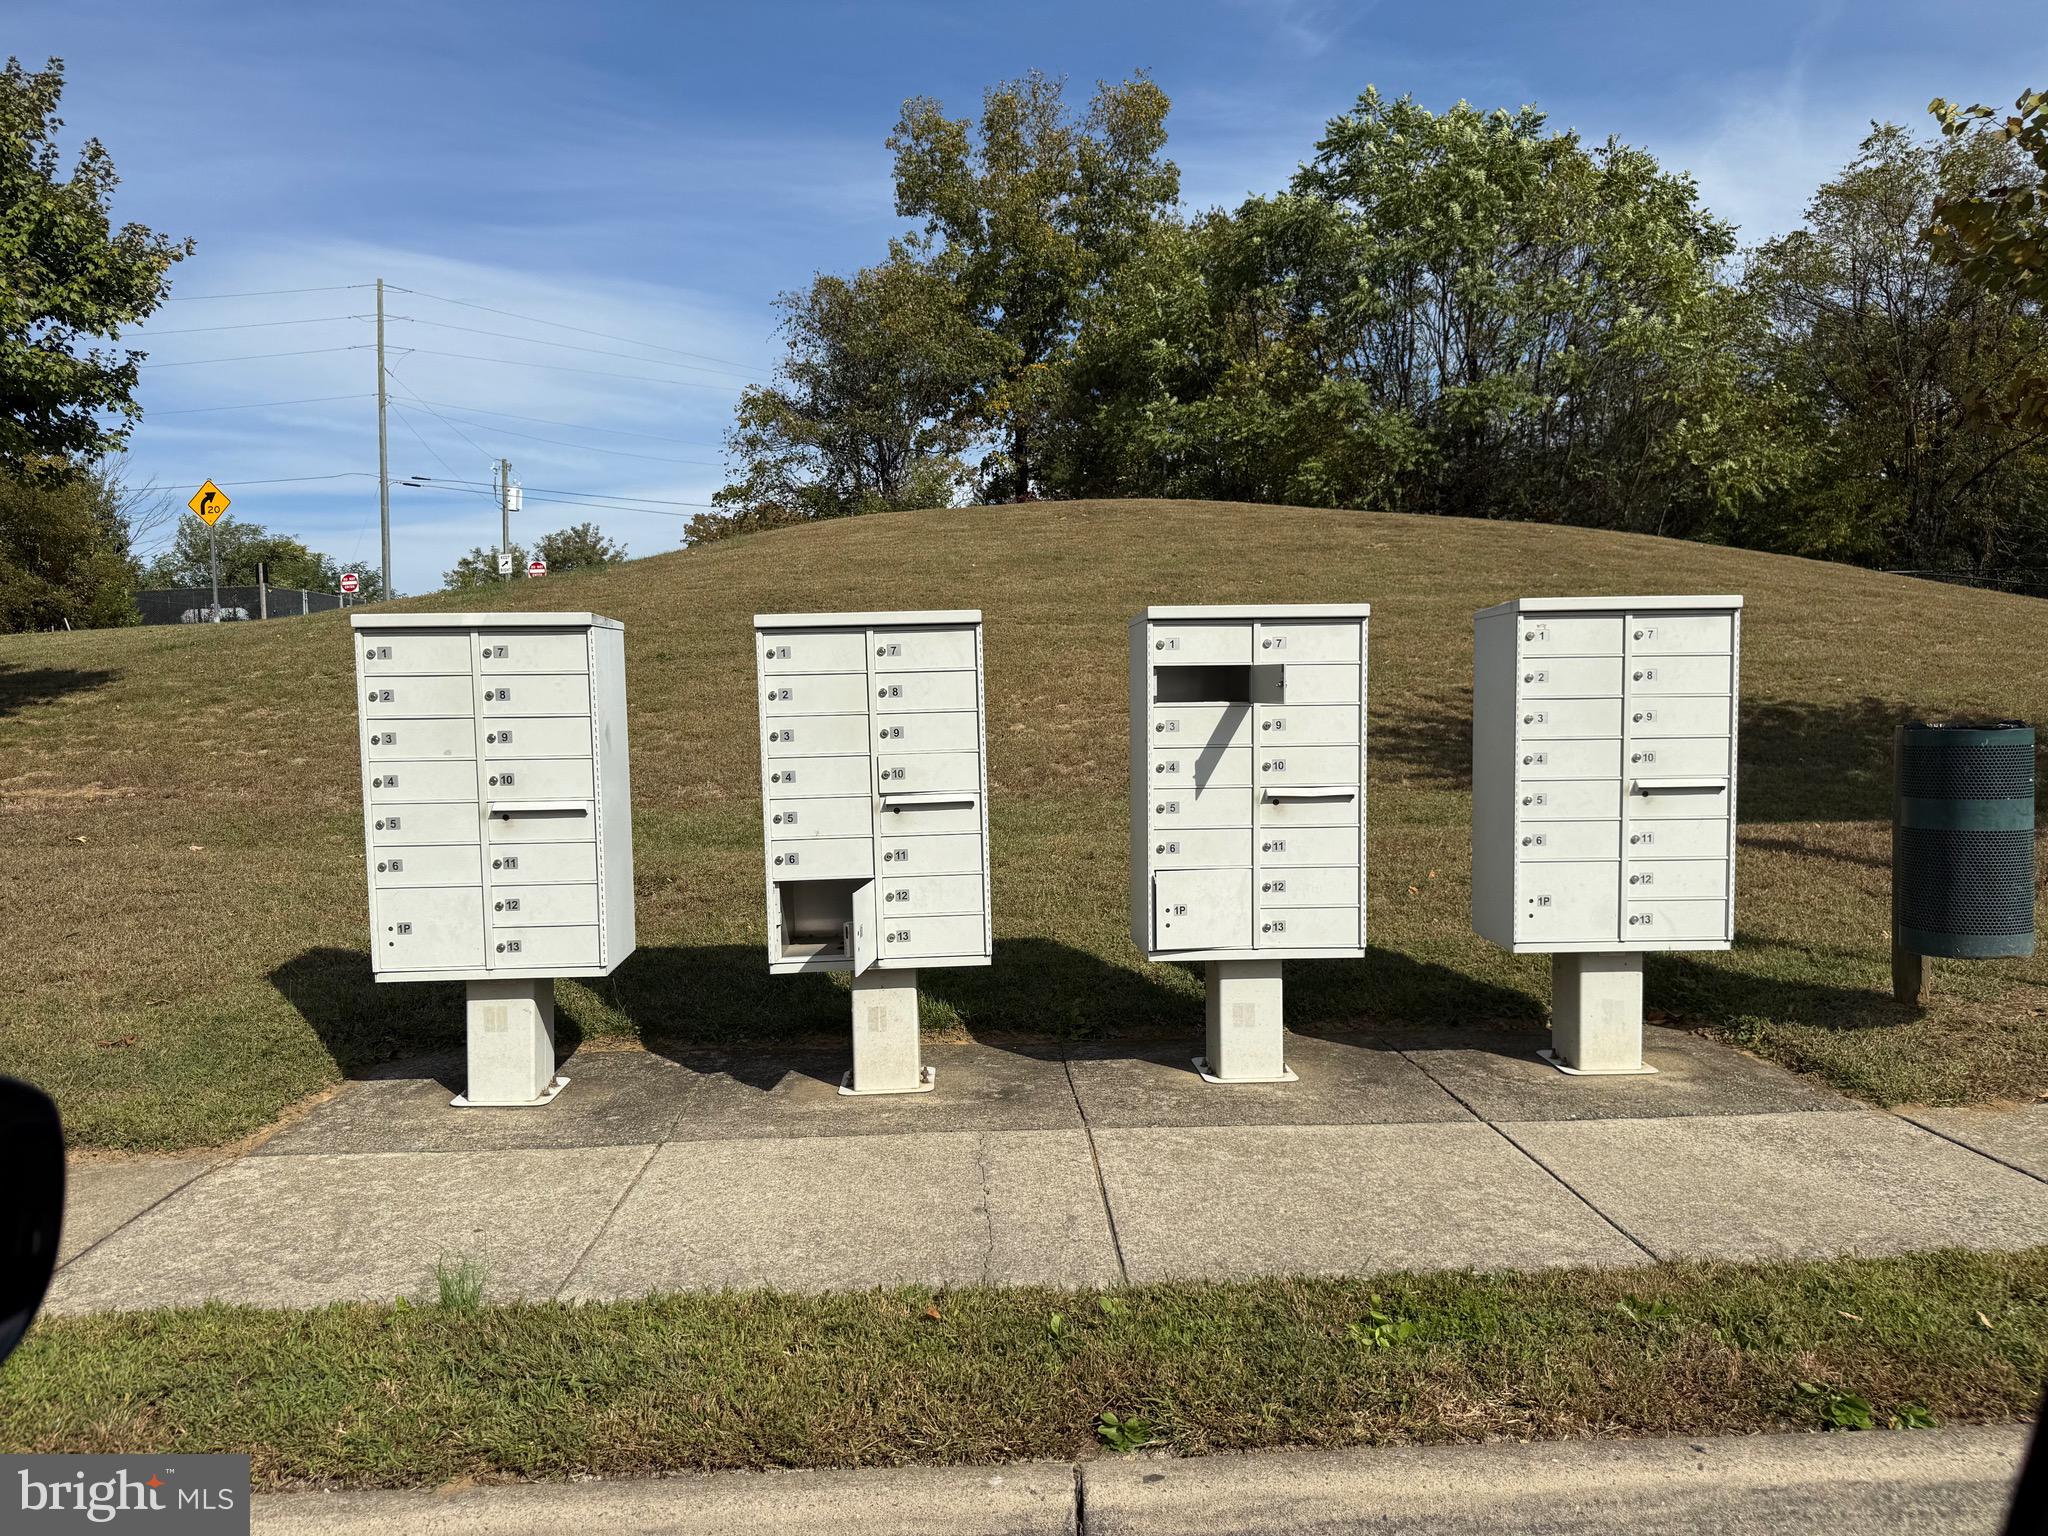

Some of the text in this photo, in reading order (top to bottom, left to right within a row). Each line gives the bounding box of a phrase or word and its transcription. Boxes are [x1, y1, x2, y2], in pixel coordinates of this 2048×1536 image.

[208, 505, 220, 514] 20
[1539, 631, 1544, 641] 1
[1647, 629, 1654, 639] 7
[1169, 639, 1175, 649] 1
[1276, 638, 1282, 648] 7
[381, 648, 387, 659] 1
[497, 647, 504, 657] 7
[780, 648, 786, 658] 1
[890, 646, 897, 656] 7
[1537, 672, 1545, 682] 2
[1646, 670, 1653, 680] 8
[383, 691, 391, 701] 2
[499, 690, 506, 700] 8
[782, 690, 789, 700] 2
[892, 687, 899, 697] 8
[1537, 713, 1544, 723] 3
[1646, 712, 1653, 721] 9
[1169, 721, 1176, 731] 3
[1275, 720, 1282, 730] 9
[501, 732, 508, 742] 9
[783, 731, 790, 741] 3
[893, 728, 900, 738] 9
[385, 734, 393, 744] 3
[1536, 754, 1544, 763] 4
[1642, 753, 1654, 762] 10
[1169, 762, 1176, 772] 4
[1272, 761, 1284, 770] 10
[785, 772, 792, 782] 4
[892, 769, 904, 779] 10
[387, 776, 394, 786] 4
[500, 775, 513, 785] 10
[1536, 795, 1543, 805] 5
[1169, 803, 1176, 813] 5
[787, 813, 794, 823] 5
[390, 819, 397, 829] 5
[1536, 836, 1543, 845] 6
[1641, 833, 1652, 843] 11
[1169, 843, 1176, 853] 6
[1273, 841, 1283, 851] 11
[788, 854, 796, 864] 6
[895, 851, 906, 860] 11
[392, 861, 399, 871] 6
[504, 858, 516, 868] 11
[1640, 874, 1652, 884] 12
[1272, 882, 1284, 891] 12
[896, 891, 908, 900] 12
[506, 900, 518, 910] 12
[1538, 896, 1550, 906] 1P
[1174, 905, 1186, 915] 1P
[1639, 914, 1651, 924] 13
[397, 924, 411, 934] 1P
[1272, 922, 1284, 932] 13
[897, 931, 909, 941] 13
[507, 942, 520, 952] 13
